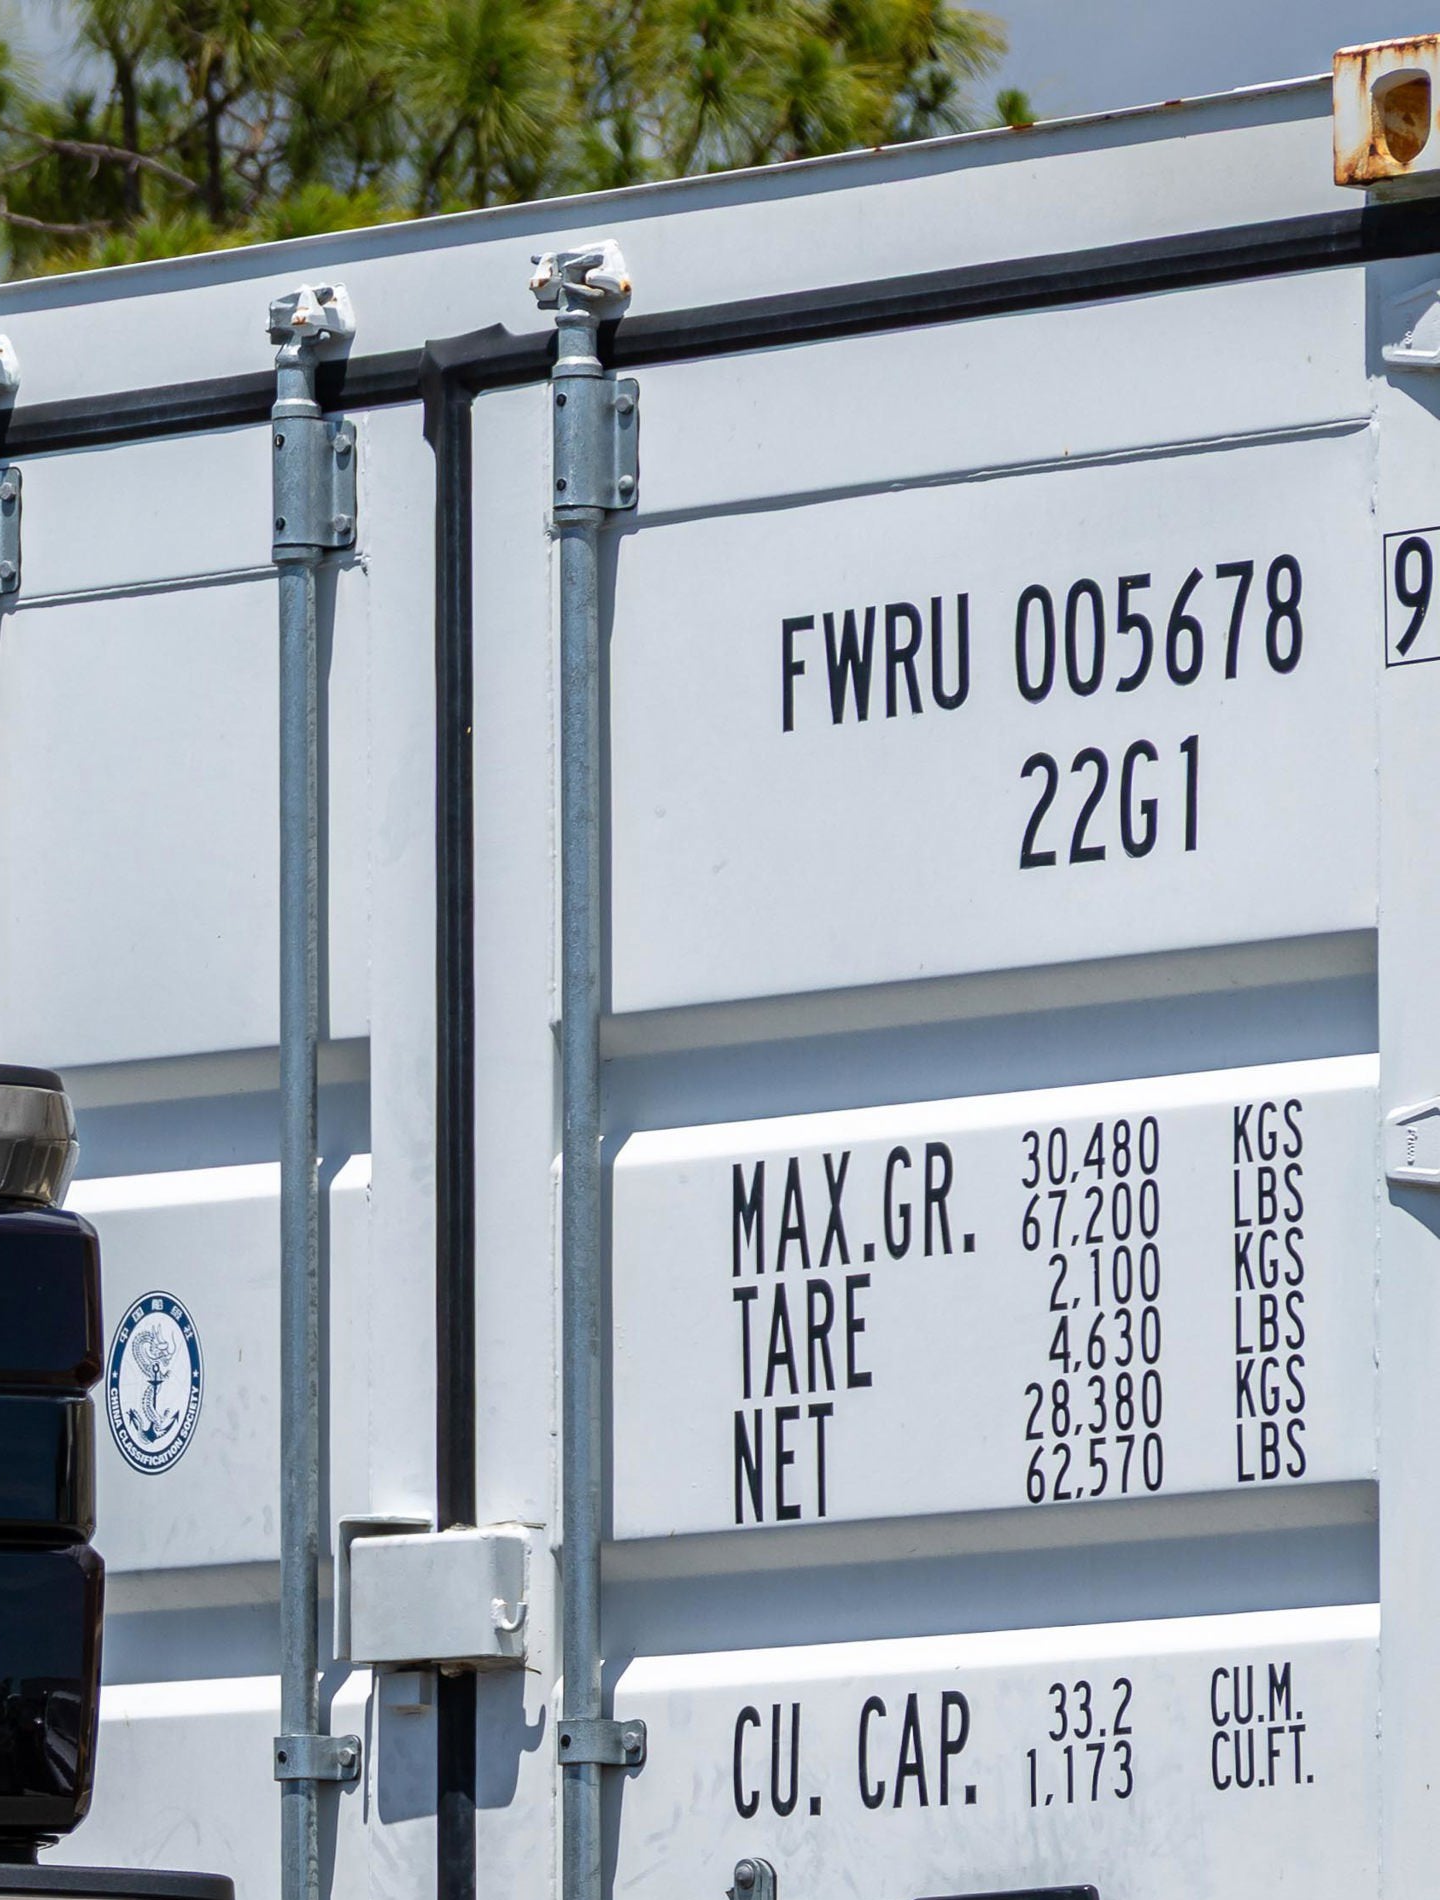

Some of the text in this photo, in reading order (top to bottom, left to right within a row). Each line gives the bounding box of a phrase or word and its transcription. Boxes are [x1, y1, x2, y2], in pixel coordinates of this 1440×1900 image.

[783, 536, 1433, 732] FWRU 005678 9
[1019, 735, 1199, 869] 22G1
[733, 1099, 1303, 1277] MAX.GR. 30,480 KGS
[1022, 1163, 1304, 1252] 67,200 LBS
[733, 1227, 1304, 1399] TARE 2,100 KGS
[1049, 1290, 1305, 1374] 4,630 LBS
[110, 1385, 200, 1466] CHINA CLASSIFICATION SOCIETY
[735, 1354, 1306, 1524] NET 28,380 KGS
[1026, 1418, 1307, 1505] 62,570 LBS
[733, 1662, 1303, 1819] CU. CAP. 33.2 CU.M.
[1026, 1724, 1314, 1808] 1,173 CU.FT.
